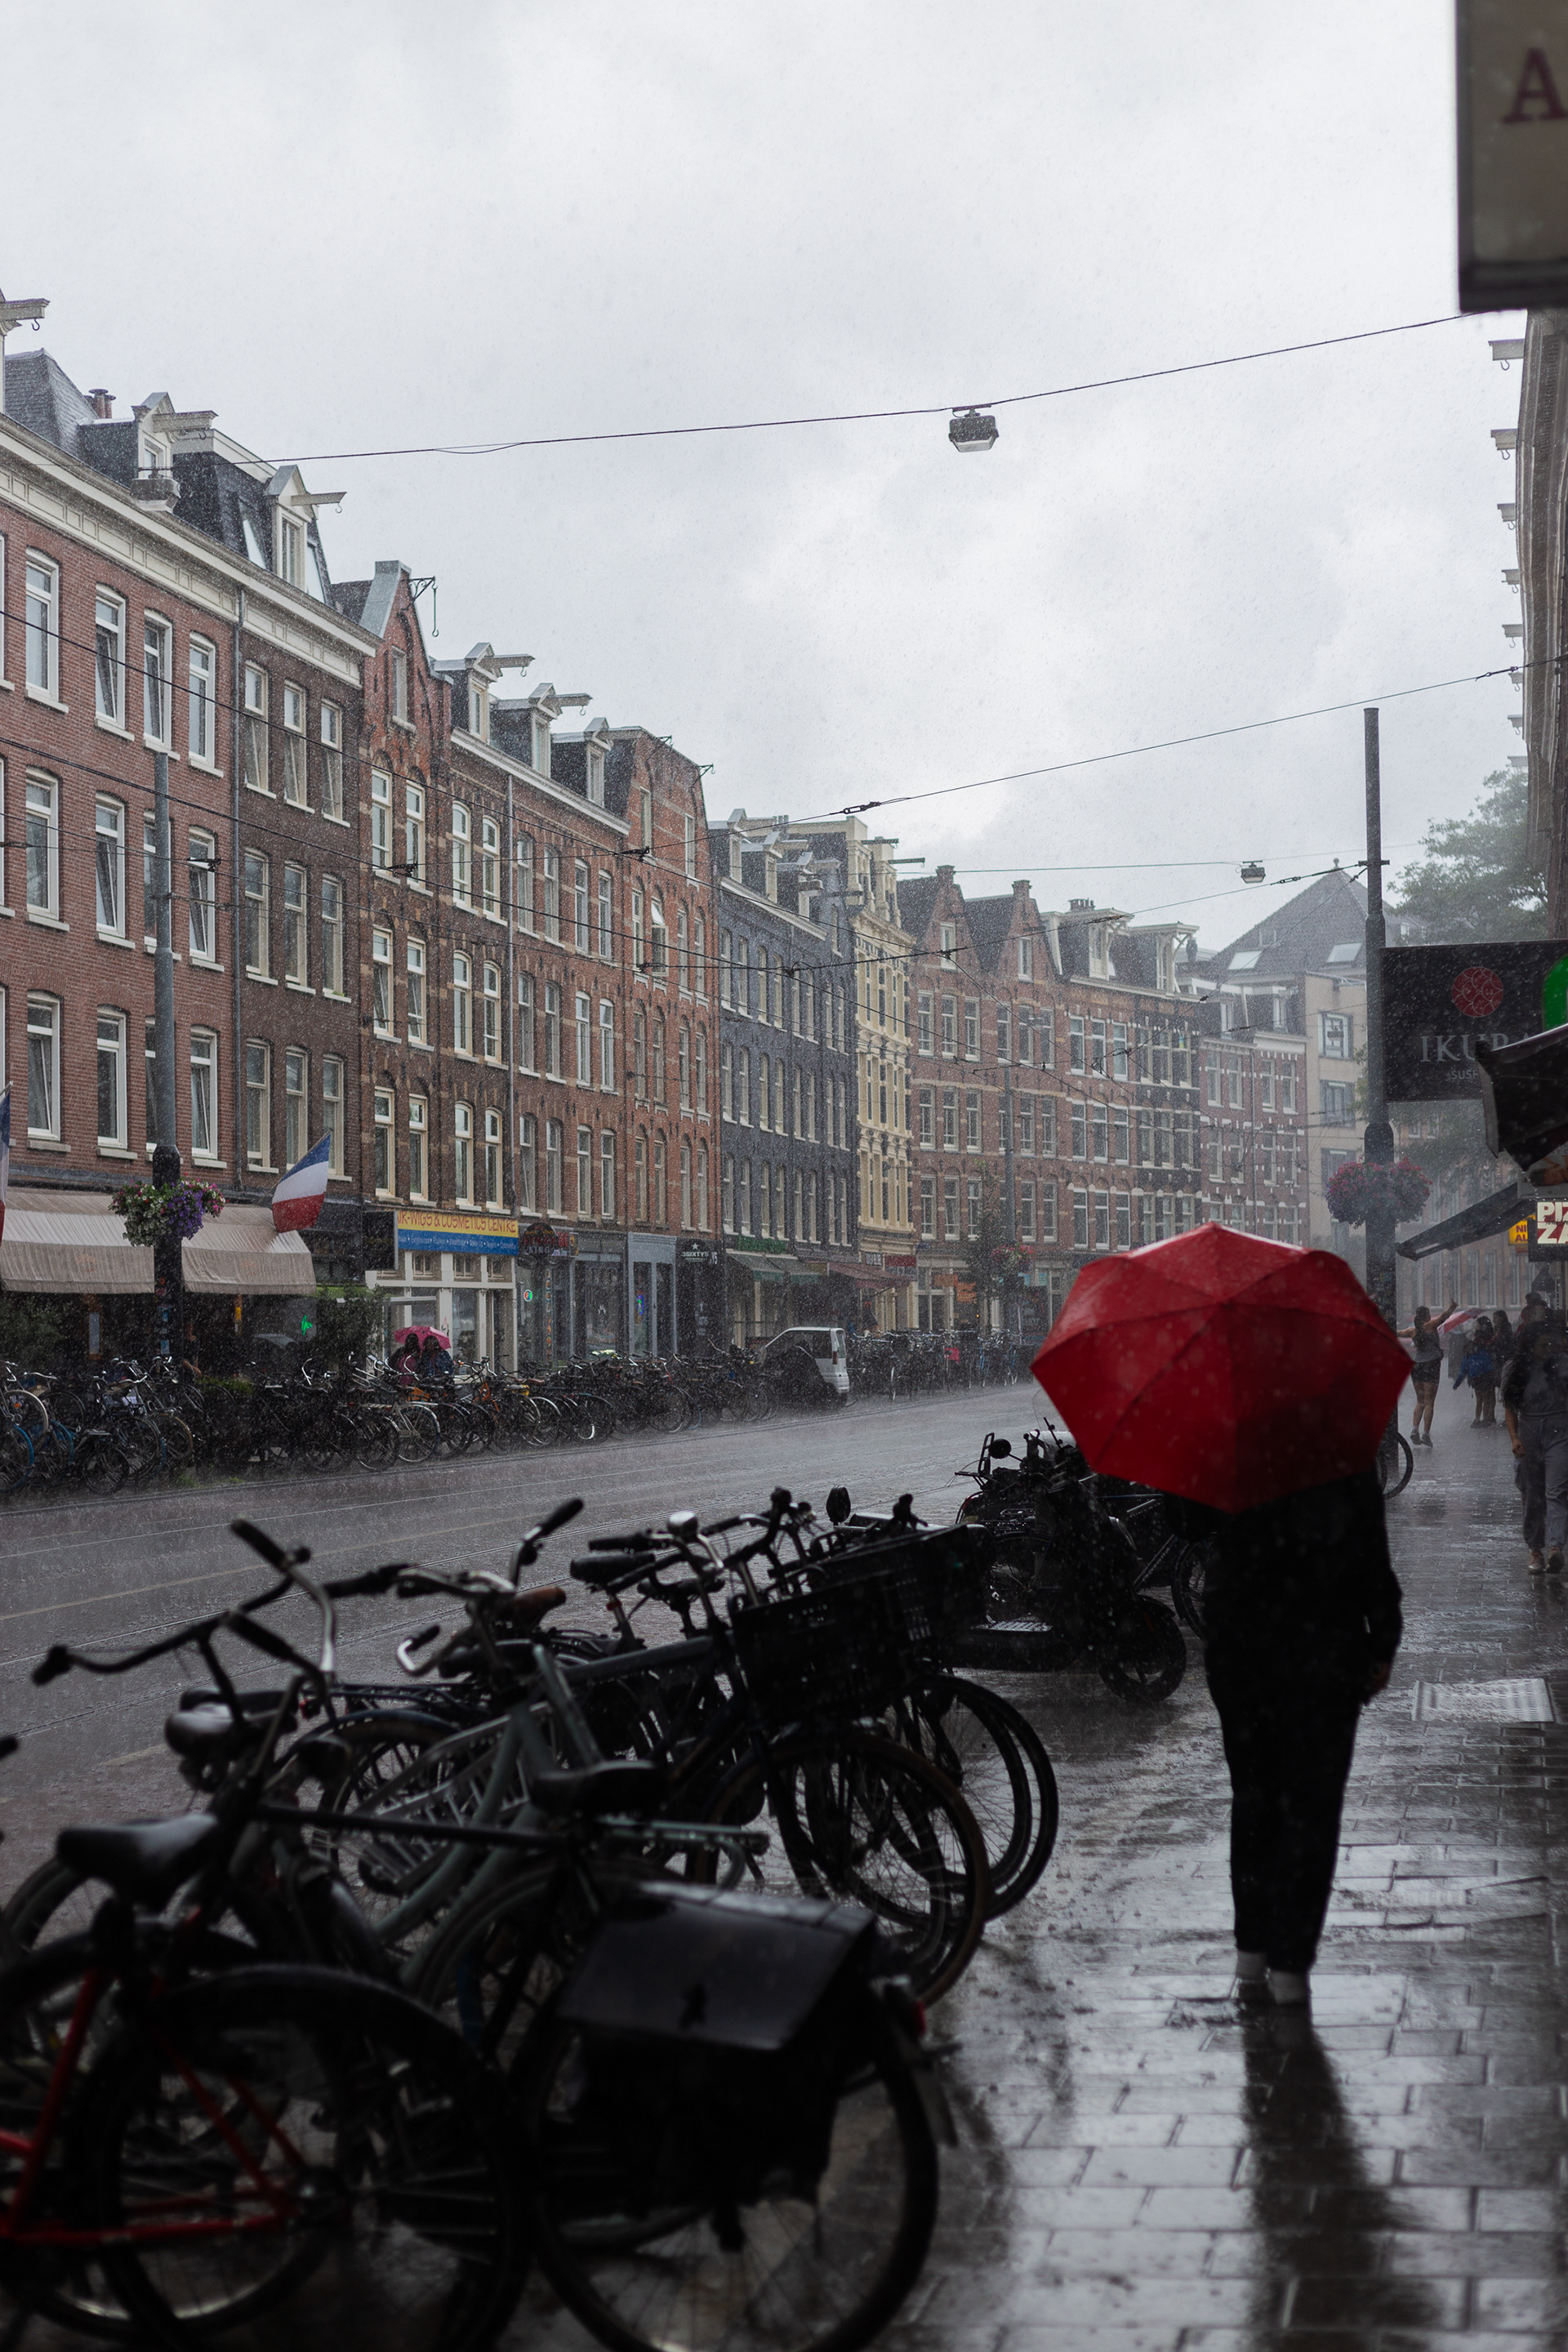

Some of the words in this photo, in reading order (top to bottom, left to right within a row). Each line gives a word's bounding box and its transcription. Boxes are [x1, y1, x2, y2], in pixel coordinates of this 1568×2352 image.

[1420, 1032, 1530, 1062] IKUR
[1537, 1201, 1568, 1222] PI
[441, 1214, 487, 1231] COSMETICS
[488, 1218, 516, 1233] CENTRE
[528, 1245, 550, 1254] KING
